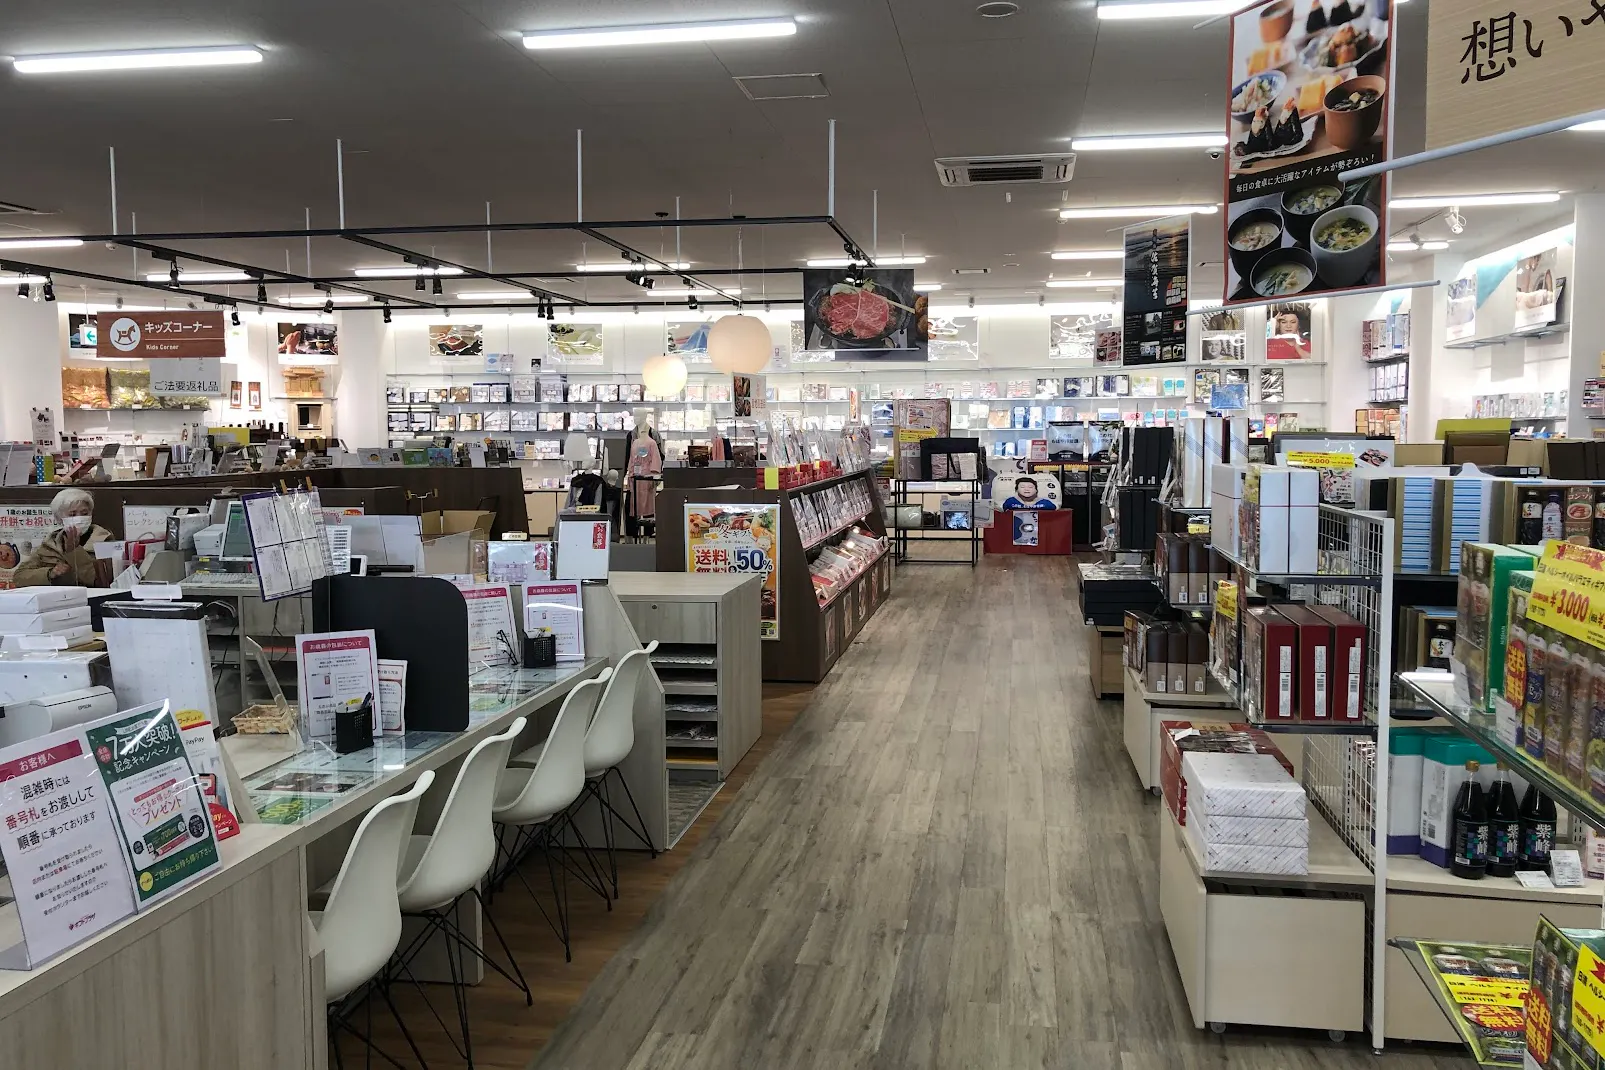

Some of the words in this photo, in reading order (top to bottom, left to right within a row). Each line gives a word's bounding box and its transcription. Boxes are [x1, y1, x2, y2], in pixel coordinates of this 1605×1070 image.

[144, 321, 213, 334] キッズコーナー
[154, 381, 219, 392] ご法要返礼品
[695, 549, 728, 566] 送料
[737, 549, 773, 571] 50%
[186, 736, 205, 746] PayPay
[19, 752, 57, 772] お客様へ
[113, 745, 171, 774] 記念キャンペーン
[20, 776, 71, 800] 混雑時には
[5, 786, 95, 830] 番号札をお渡しして
[142, 795, 182, 826] プレゼント
[17, 811, 97, 851] 順番に承っております
[1535, 823, 1552, 855] 紫峰
